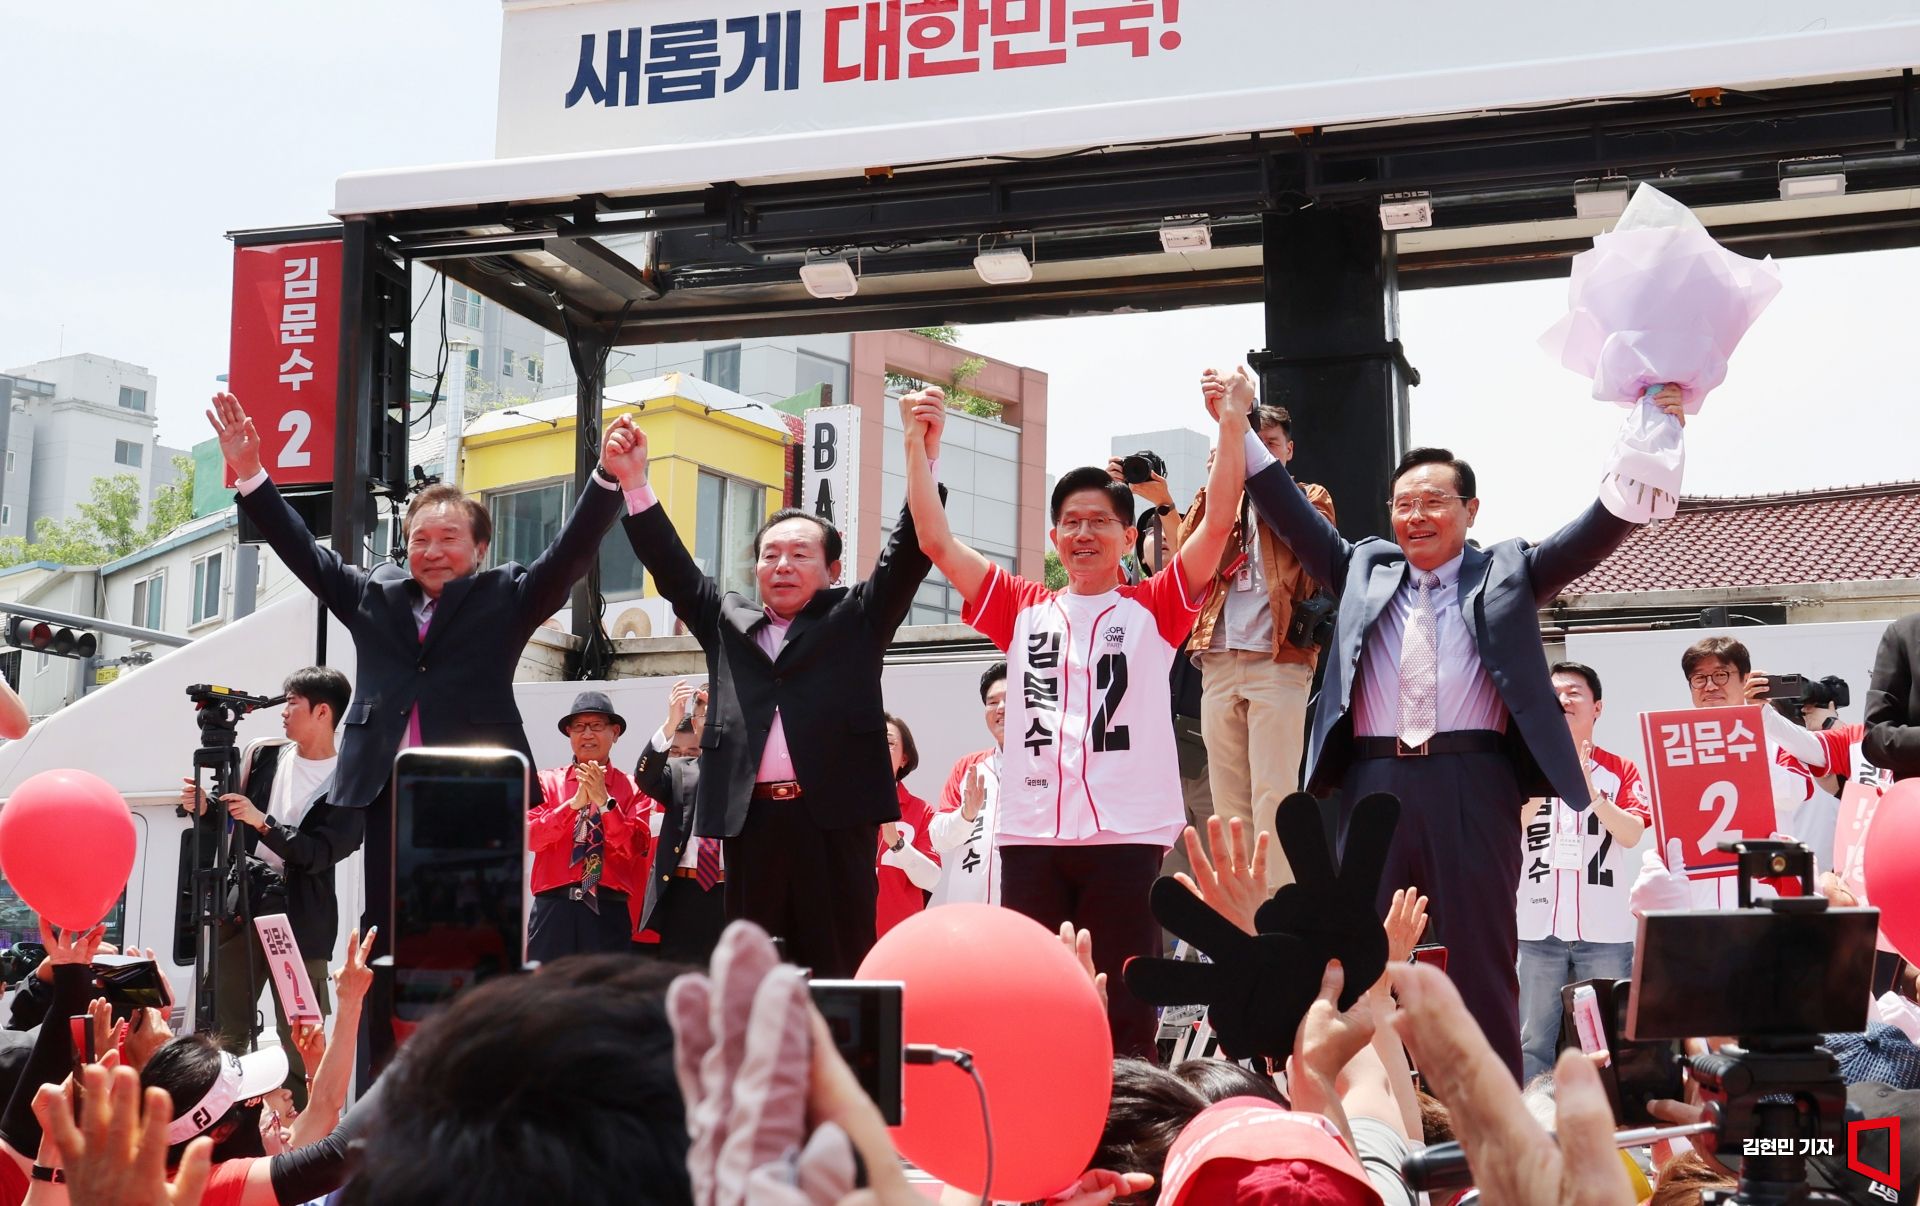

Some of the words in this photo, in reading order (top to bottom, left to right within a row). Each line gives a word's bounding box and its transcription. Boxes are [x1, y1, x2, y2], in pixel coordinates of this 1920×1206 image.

[565, 9, 801, 109] 새롭게
[823, 0, 1182, 83] 대한민국!
[278, 257, 318, 391] 김문수
[277, 410, 312, 468] 2
[1024, 632, 1062, 757] 김문수
[1092, 651, 1130, 752] 2
[1661, 719, 1757, 767] 김문수
[1587, 811, 1614, 887] 2
[1697, 780, 1743, 856] 2
[263, 927, 293, 955] 김문수
[284, 961, 306, 1010] 2
[193, 1107, 212, 1130] FJ
